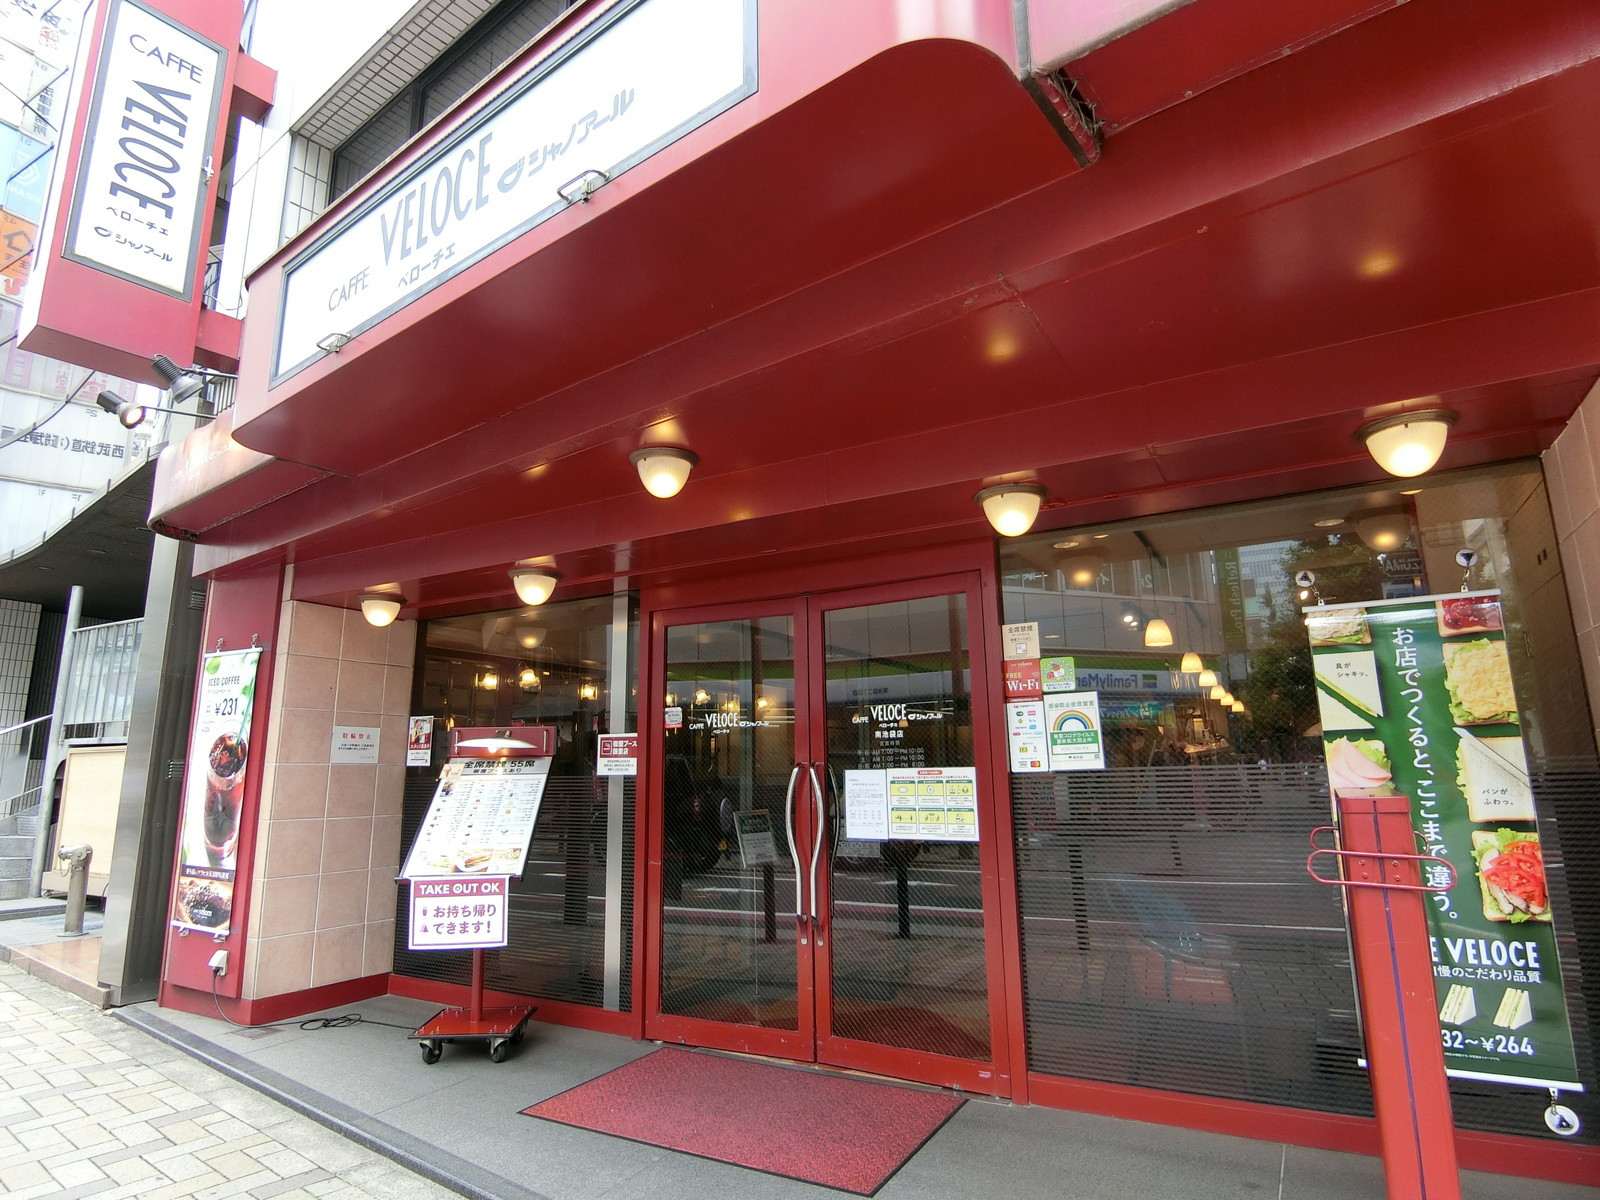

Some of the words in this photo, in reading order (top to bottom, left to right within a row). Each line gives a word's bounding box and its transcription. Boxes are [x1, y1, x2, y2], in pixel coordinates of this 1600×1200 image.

[129, 34, 203, 84] CAFFE
[529, 88, 635, 177] シャノアール
[109, 80, 192, 219] VELOCE
[380, 131, 493, 267] VELOCE
[106, 206, 169, 237] ベローチェ
[115, 233, 173, 263] シャノアール
[397, 242, 456, 288] ベローチェ
[328, 266, 371, 312] CAFFE
[1007, 625, 1034, 633] 全席禁煙
[208, 677, 220, 687] ICED
[221, 675, 241, 686] COFFEE
[1006, 679, 1040, 692] Wi-Fi
[215, 697, 238, 716] ¥231
[852, 716, 869, 724] CAFFE
[870, 703, 907, 721] VELOCE
[705, 712, 738, 728] VELOCE
[875, 730, 904, 738] 南池袋店
[464, 760, 507, 769] 全席禁煙
[510, 760, 536, 768] 55席
[1391, 627, 1459, 920] お店でつくると、ここまで違う。
[419, 885, 450, 895] TAKE
[453, 883, 482, 894] OUT
[483, 882, 501, 893] OK
[433, 903, 497, 919] お持ち帰り
[433, 920, 491, 935] できます！
[1443, 937, 1540, 968] VELOCE
[1441, 1029, 1534, 1056] 32～¥264
